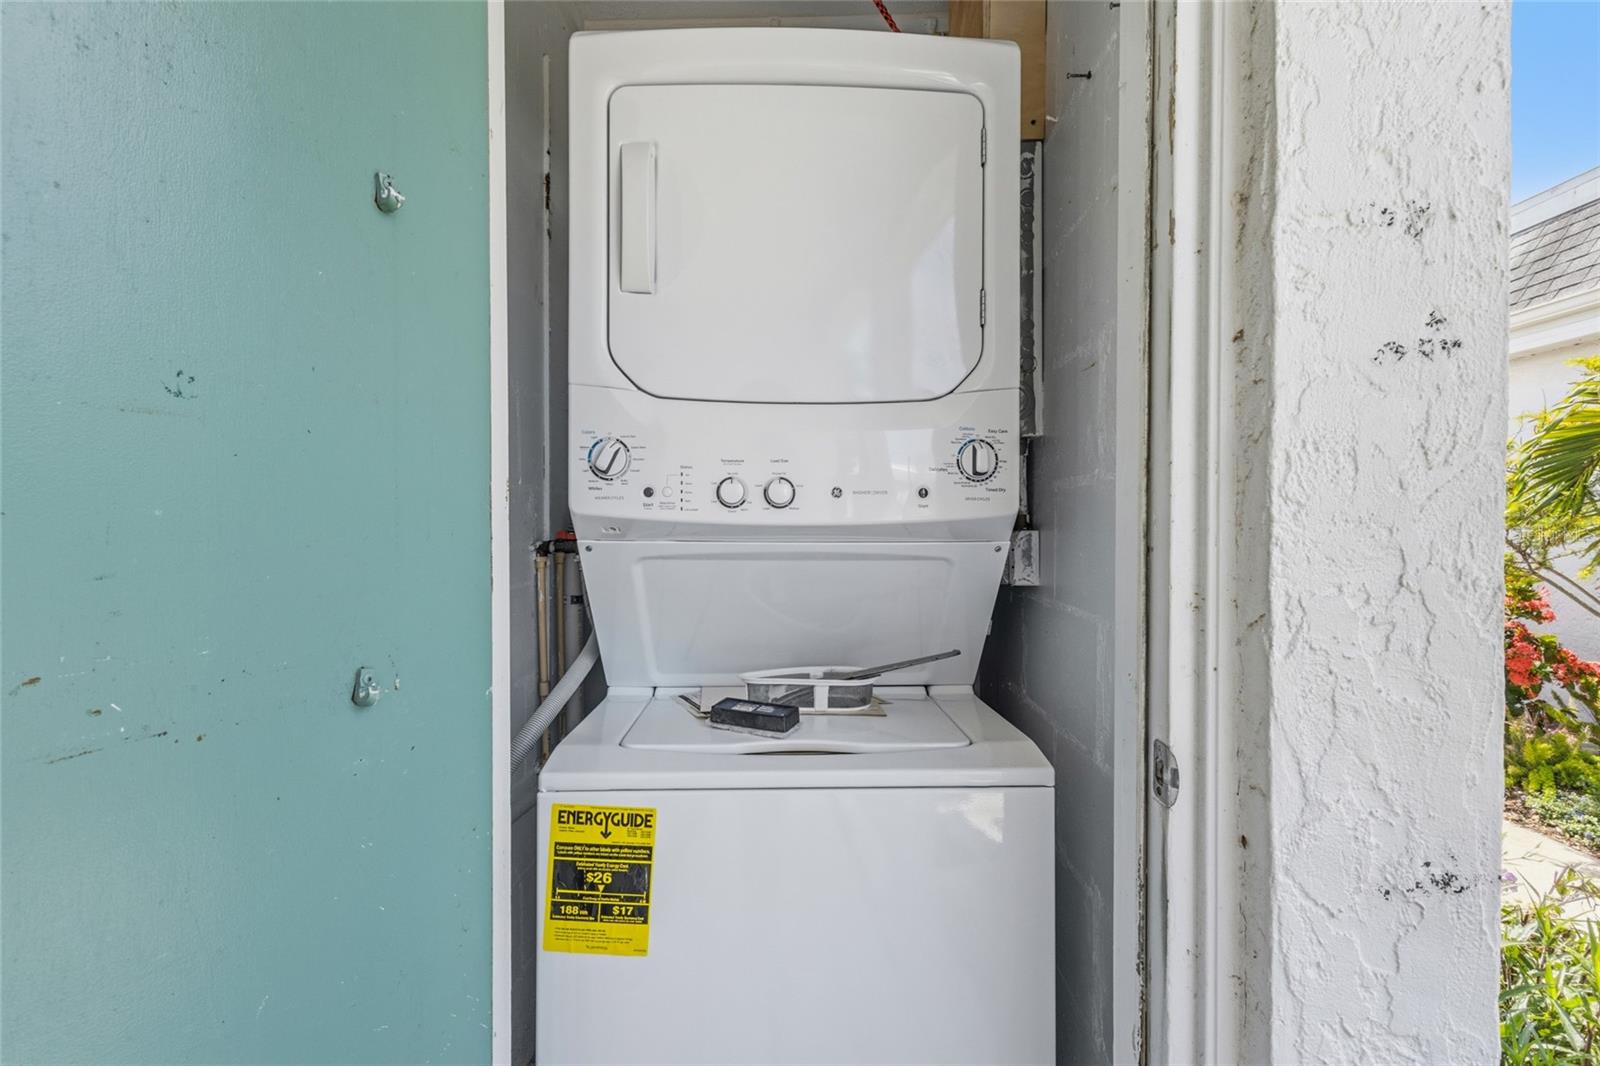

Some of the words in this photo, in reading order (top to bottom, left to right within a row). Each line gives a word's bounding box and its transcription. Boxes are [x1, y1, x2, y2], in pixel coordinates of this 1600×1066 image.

[558, 810, 653, 828] ENERGYGUIDE
[586, 872, 612, 884] $26
[560, 905, 579, 915] 188
[612, 906, 634, 916] $17
